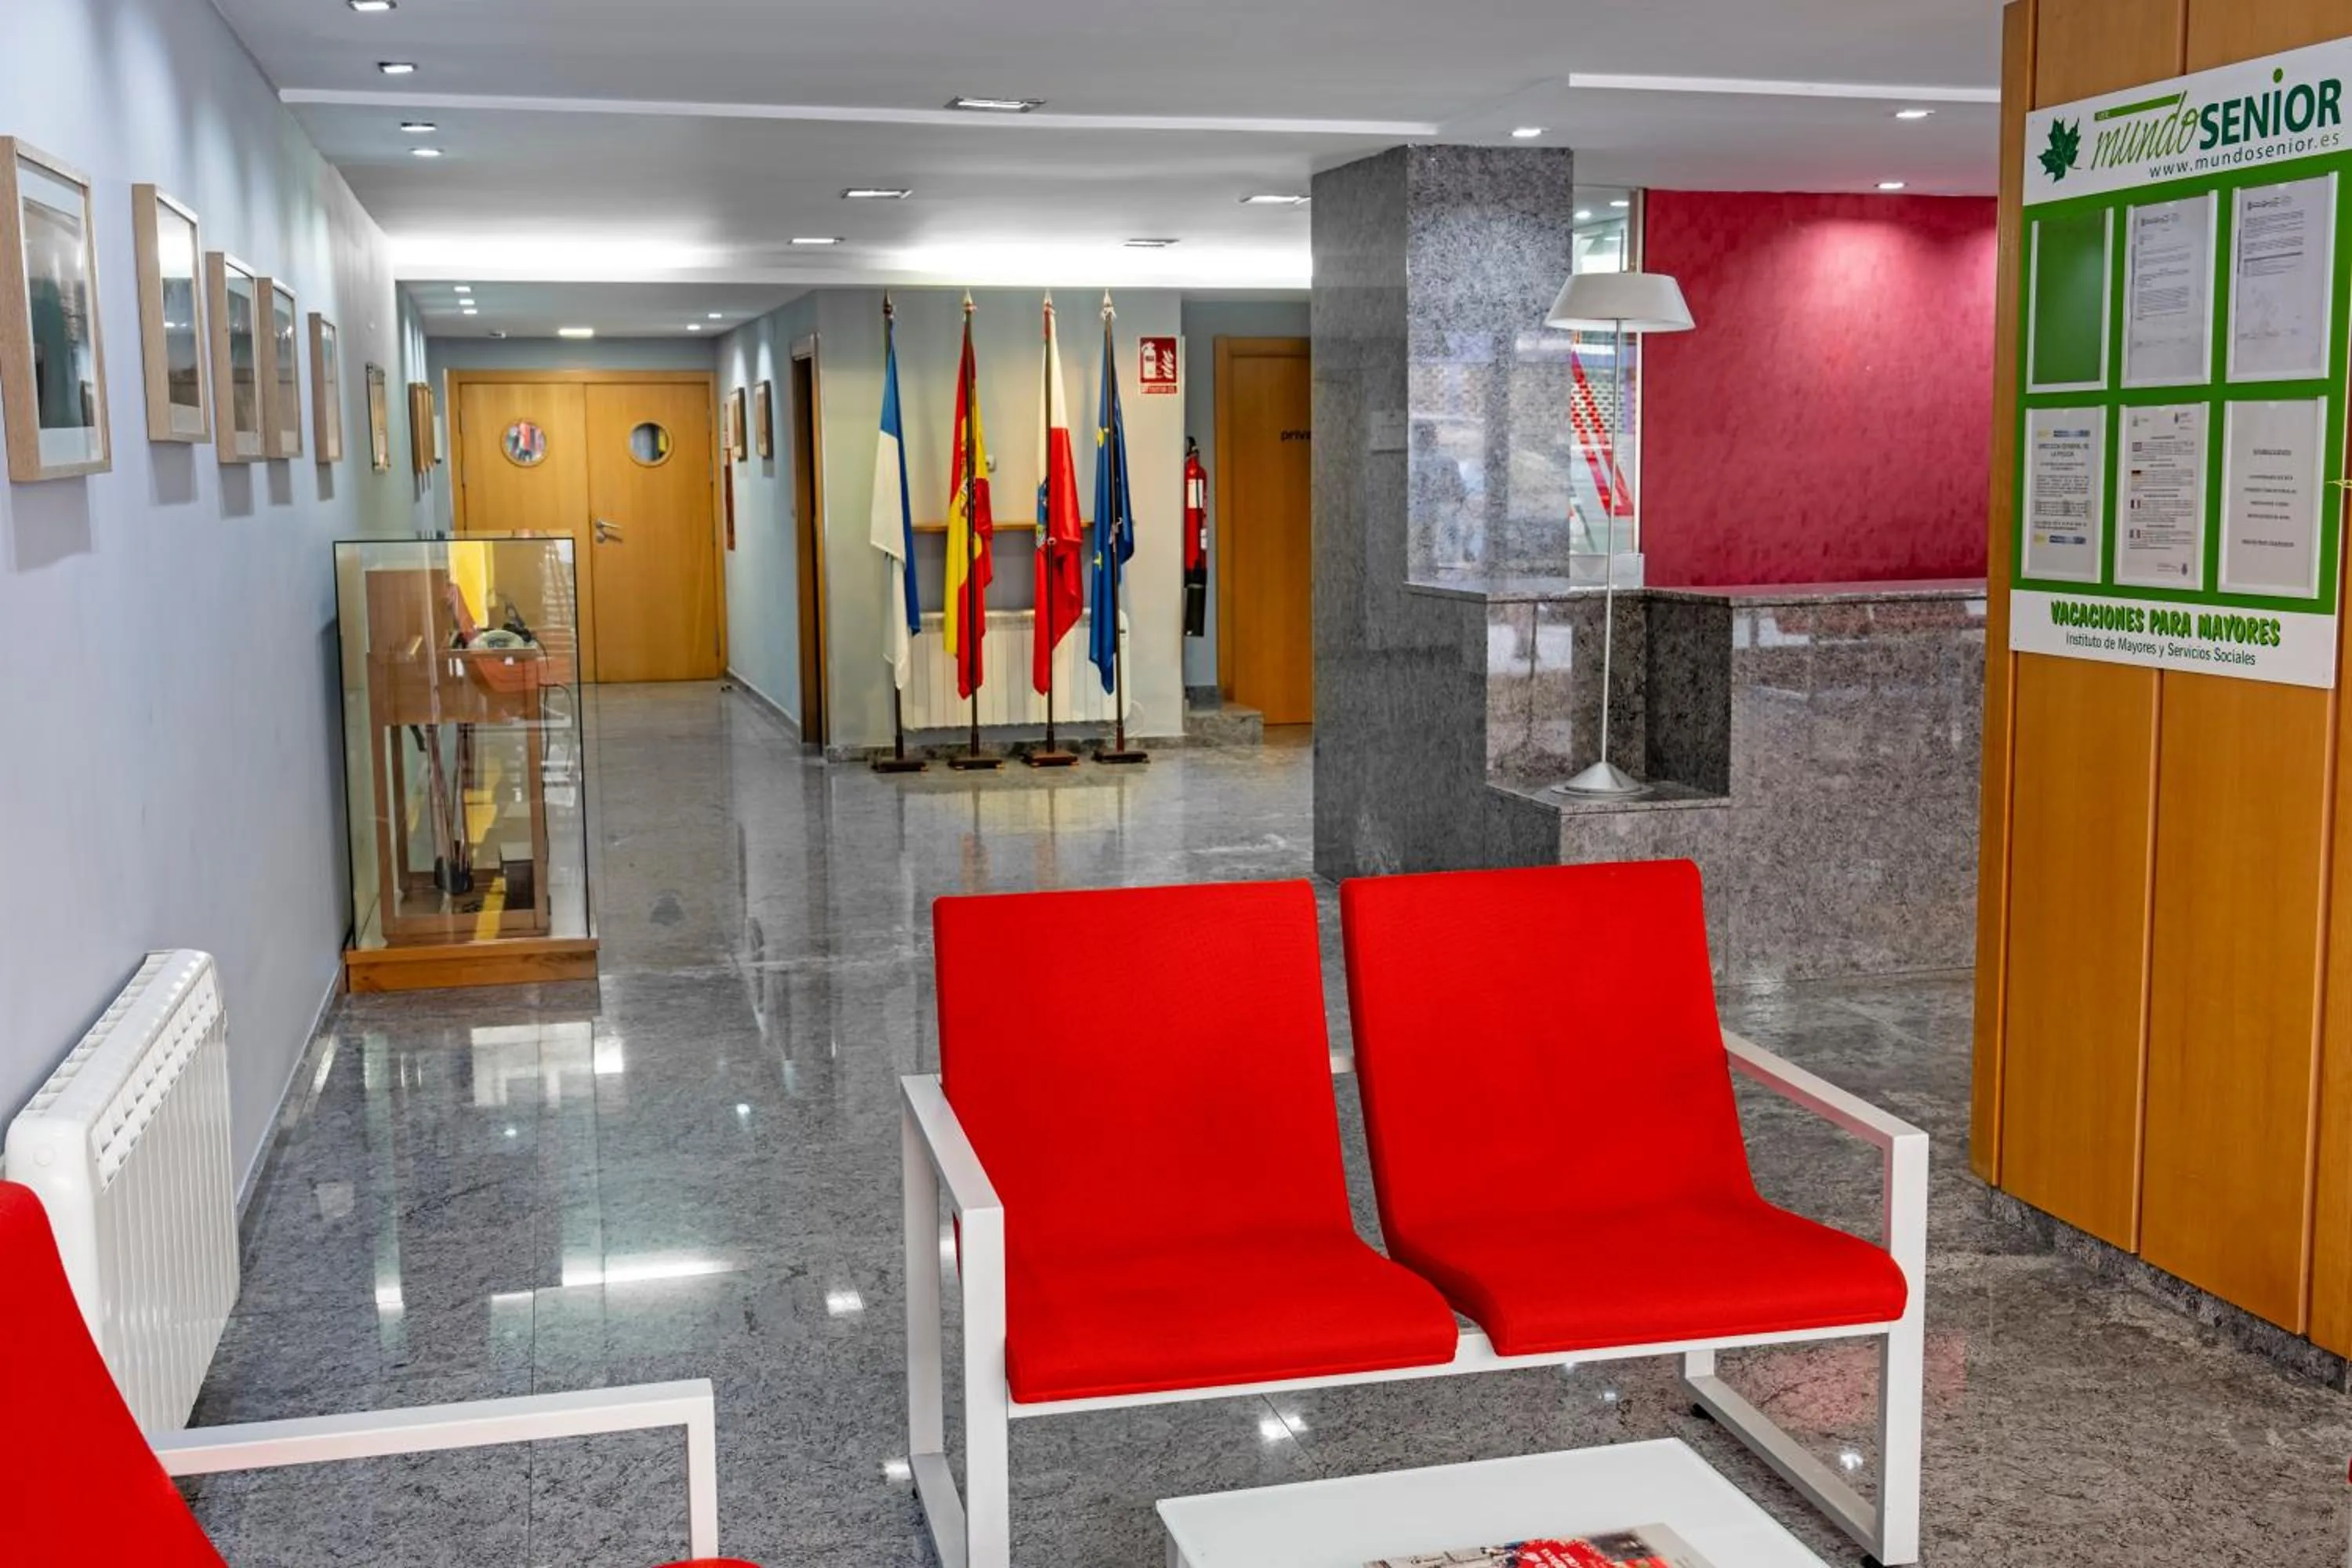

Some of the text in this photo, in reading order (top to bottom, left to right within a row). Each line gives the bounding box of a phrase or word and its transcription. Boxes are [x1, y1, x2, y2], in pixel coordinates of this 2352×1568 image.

[2150, 133, 2340, 178] www.mundosenior.es
[2051, 600, 2281, 648] VACACIONES PARA MAYORES
[2066, 633, 2256, 666] Instituto de Mayores y Servicios Sociales
